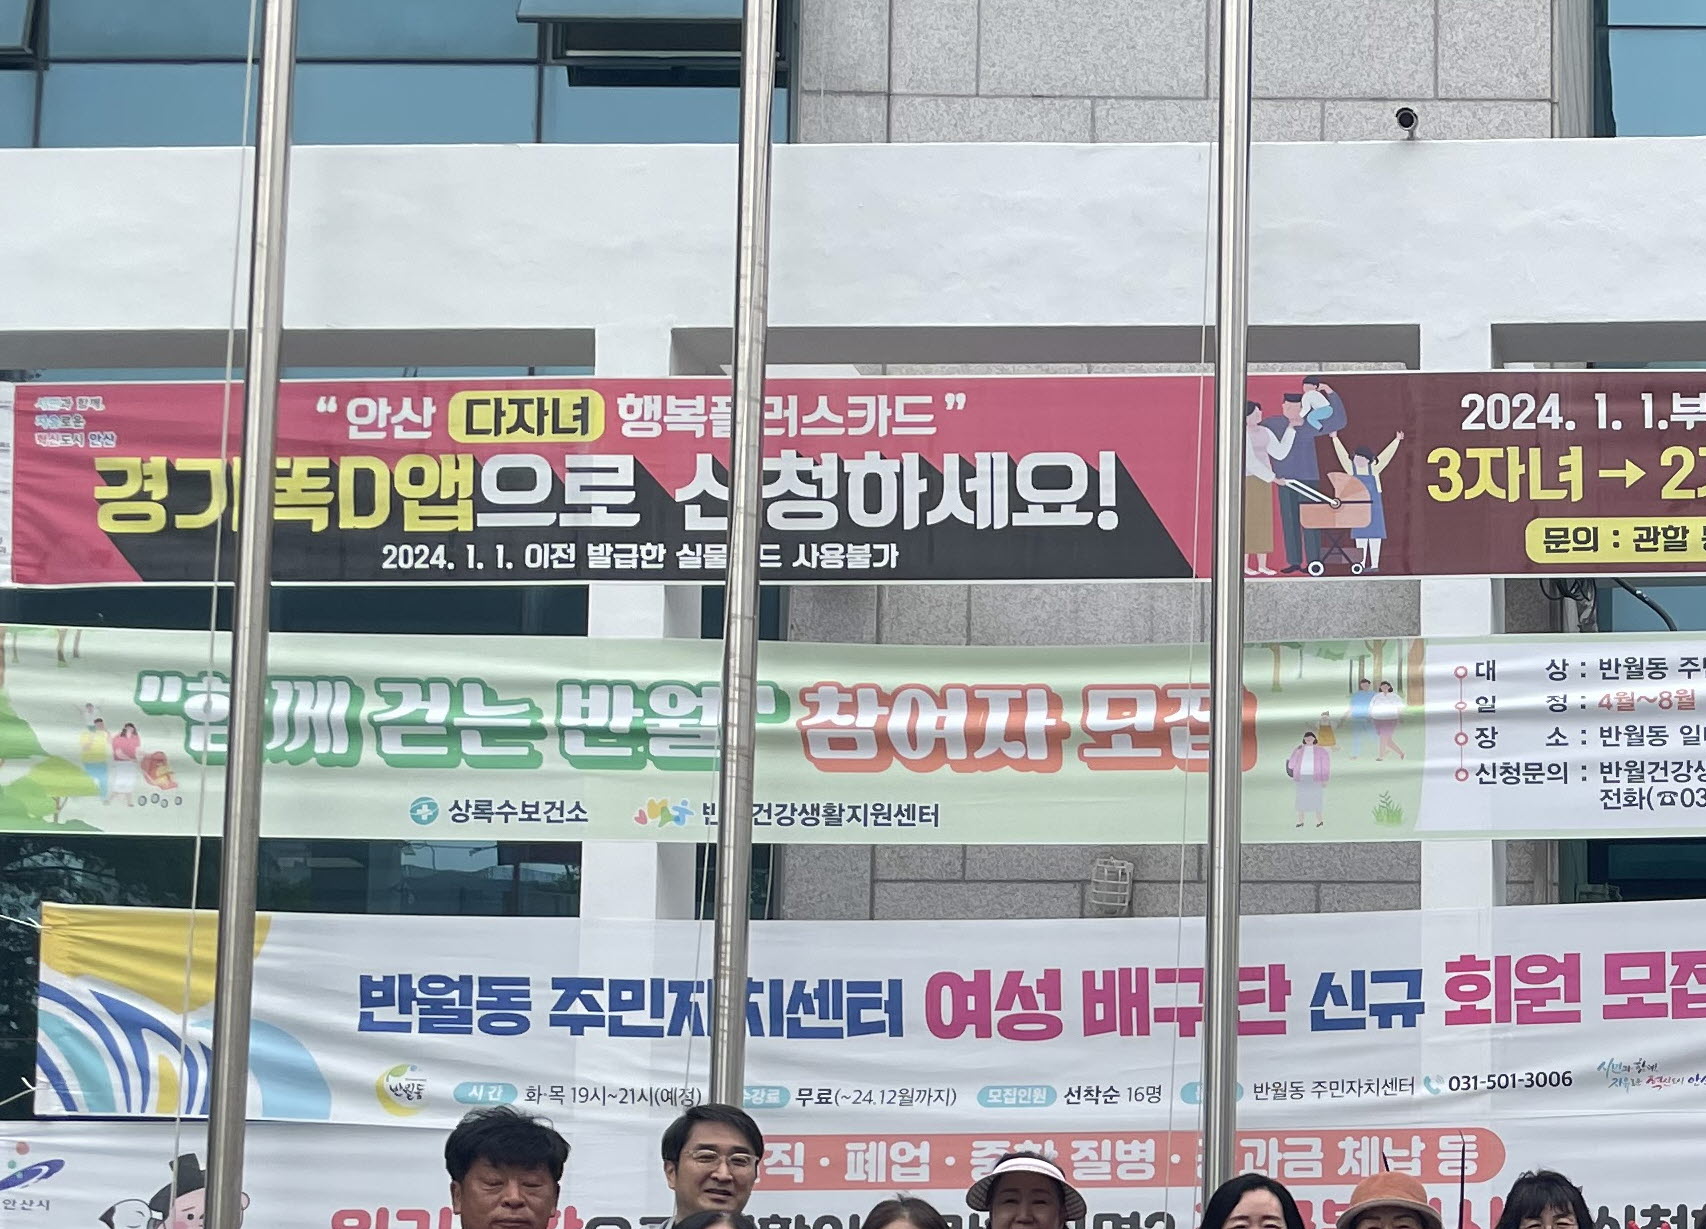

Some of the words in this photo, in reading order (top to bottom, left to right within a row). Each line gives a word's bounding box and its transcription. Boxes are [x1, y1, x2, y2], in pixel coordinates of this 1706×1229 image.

[465, 396, 590, 437] 다자녀
[1461, 392, 1576, 431] 2024.
[1594, 392, 1623, 431] 1.
[1426, 445, 1584, 503] 3자녀
[674, 449, 1119, 532] 신청하세요!
[1543, 525, 1599, 554] 문의
[1632, 524, 1690, 553] 관할
[381, 544, 455, 570] 2024.
[466, 544, 484, 570] 1.
[496, 544, 514, 570] 1.
[524, 543, 577, 570] 이전
[587, 542, 667, 570] 발급한
[675, 542, 783, 569] 실물드
[791, 542, 900, 569] 사용불가
[1475, 659, 1497, 682] 대
[1545, 658, 1569, 682] 상
[1599, 656, 1669, 681] 반월동
[1475, 695, 1497, 714] 일
[1545, 693, 1568, 713] 정
[1597, 688, 1697, 712] 4월~8월
[374, 680, 539, 758] 걷는
[800, 684, 1062, 762] 참여자
[1474, 726, 1499, 749] 장
[1545, 726, 1569, 747] 소
[1599, 724, 1670, 748] 반월동
[1475, 761, 1569, 786] 신청문의
[448, 798, 589, 826] 상록수보건소
[702, 801, 940, 828] 반건강생활지원센터
[357, 973, 533, 1037] 반월동
[549, 976, 904, 1040] 주민자치센터
[925, 967, 1064, 1042] 여성
[1082, 963, 1292, 1038] 배구단
[1310, 968, 1426, 1033] 신규
[1443, 952, 1583, 1028] 회원
[467, 1085, 505, 1102] 시간
[986, 1086, 1048, 1105] 모집인원
[1063, 1085, 1121, 1106] 선착순
[1126, 1083, 1162, 1104] 16명
[1252, 1080, 1306, 1102] 반월동
[1310, 1076, 1416, 1100] 주민자치센터
[1447, 1070, 1574, 1094] 031-501-3006
[844, 1140, 931, 1184] 폐업
[1070, 1138, 1156, 1182] 질병
[1196, 1135, 1324, 1179] 과금
[1337, 1134, 1425, 1178] 체납
[1436, 1133, 1478, 1176] 등
[2, 1199, 50, 1211] 안산시
